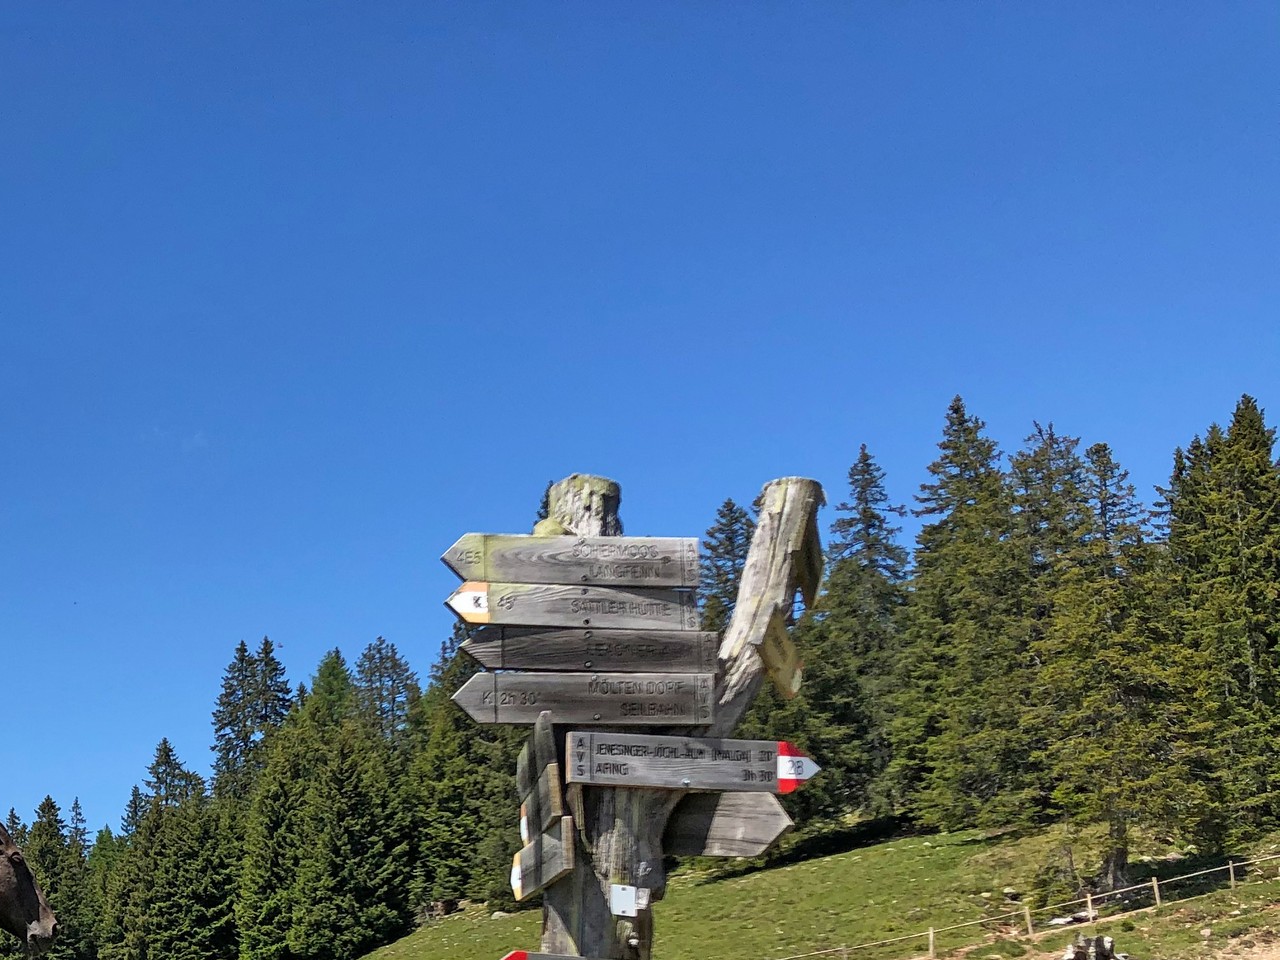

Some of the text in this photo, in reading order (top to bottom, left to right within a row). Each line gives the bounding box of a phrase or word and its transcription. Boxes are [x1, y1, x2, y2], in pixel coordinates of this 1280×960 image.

[588, 678, 685, 695] MÖLTEN DORF
[595, 762, 629, 776] AFING
